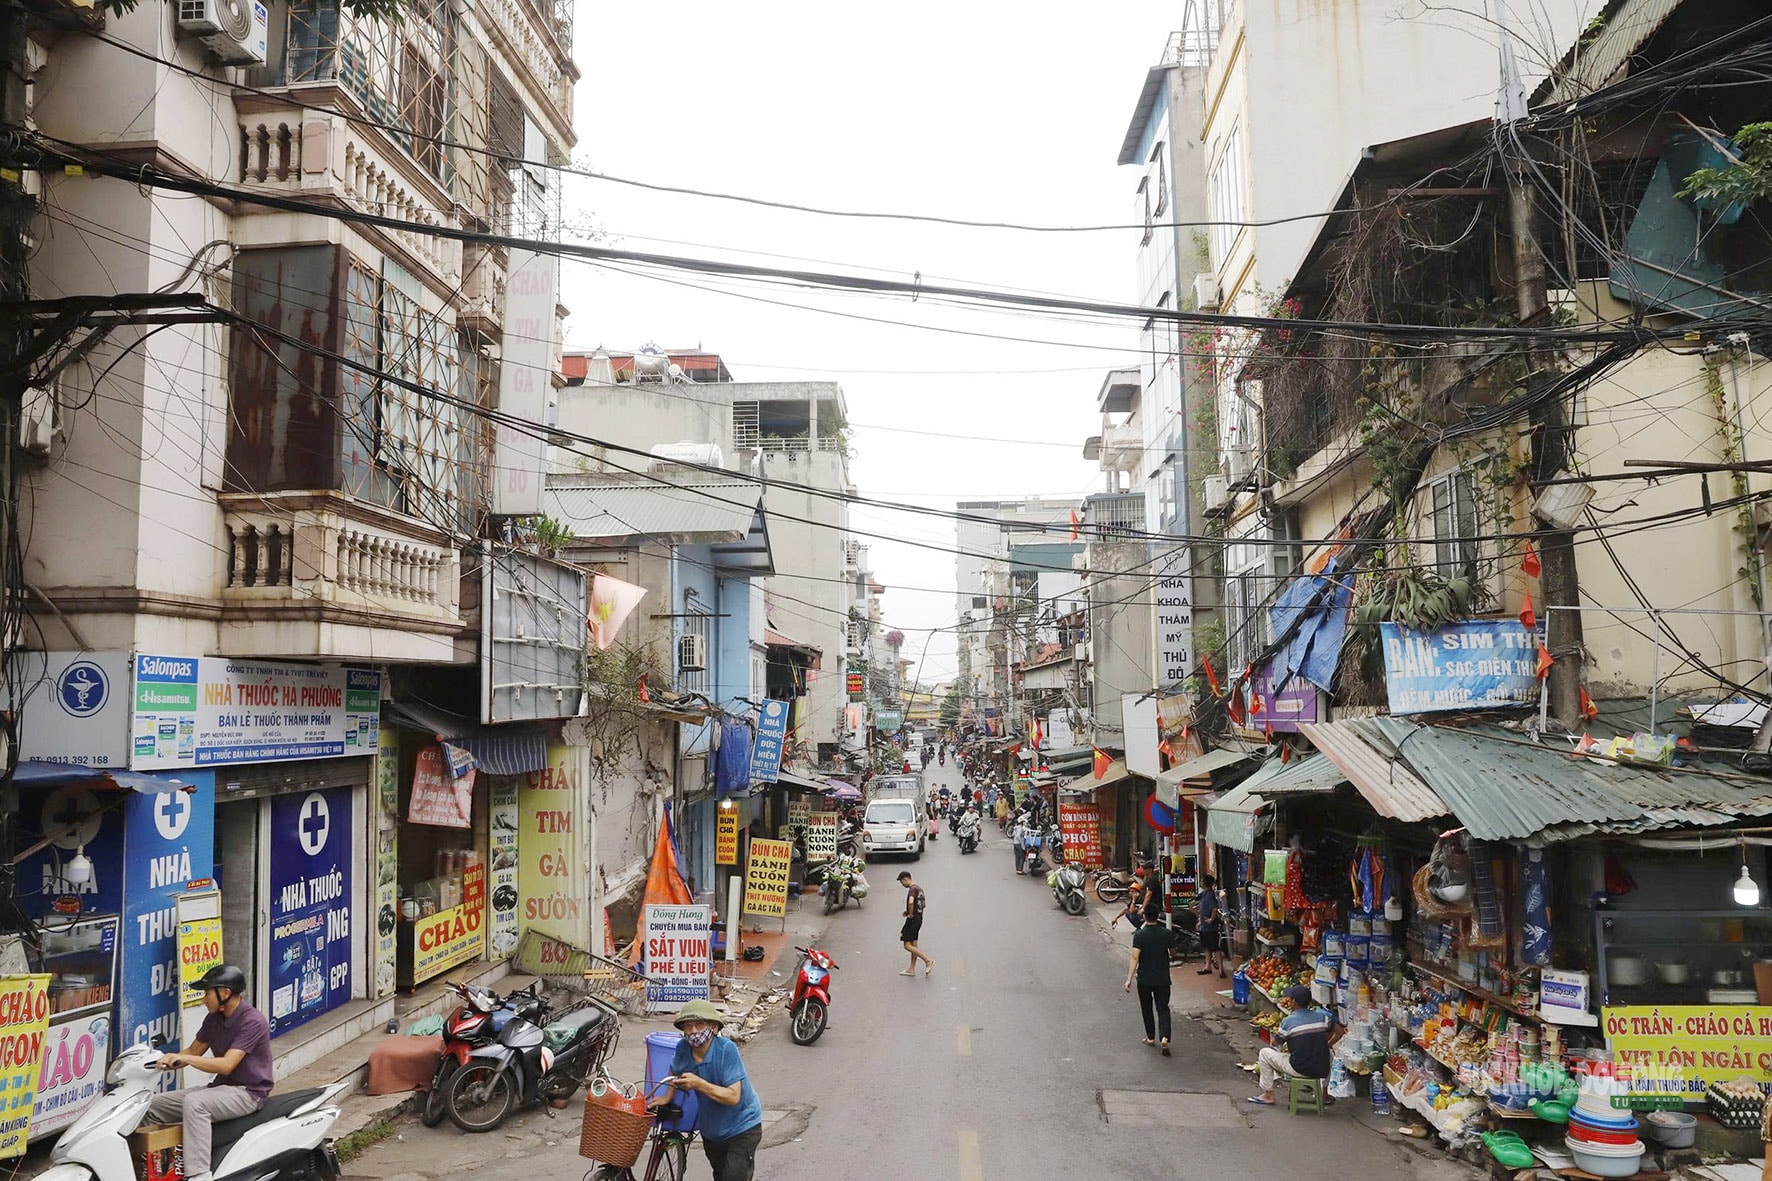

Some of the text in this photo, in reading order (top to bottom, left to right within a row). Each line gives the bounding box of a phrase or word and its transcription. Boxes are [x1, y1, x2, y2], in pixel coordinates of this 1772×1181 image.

[514, 318, 541, 345] TIM
[1160, 579, 1185, 589] NHA
[1157, 597, 1190, 608] KHOA
[1442, 632, 1494, 650] SIM
[141, 656, 192, 680] Salonpas
[205, 677, 342, 708] NHÀ THUỐC HÀ PHƯƠNG
[219, 712, 237, 728] BÁN
[254, 710, 282, 727] THUỐC
[284, 712, 309, 726] THÀNH
[71, 756, 88, 765] 392
[92, 756, 108, 765] 168
[536, 811, 573, 834] TIM
[1062, 829, 1089, 844] PHỞ
[751, 841, 790, 859] BÚN CHẢ
[1063, 846, 1085, 860] CHÁO
[150, 846, 192, 889] NHÀ
[539, 848, 569, 877] GÀ
[751, 858, 788, 871] BÁNH
[749, 870, 786, 882] CUỐN
[282, 863, 342, 913] NHÀ THUỐC
[747, 881, 785, 893] NÓNG
[137, 906, 177, 946] THU
[420, 908, 482, 953] CHÁO
[650, 922, 676, 931] CHUYÊN
[677, 923, 692, 931] MUA
[181, 938, 219, 965] CHÁO
[649, 932, 676, 958] SẮT
[330, 962, 348, 991] GPP
[650, 958, 706, 977] PHẾ LIỆU
[692, 978, 707, 986] INOX
[0, 981, 47, 1028] CHÁO
[1630, 1008, 1674, 1036] TRẦN
[1685, 1011, 1729, 1036] CHÁO
[1732, 1011, 1756, 1036] CÁ
[1701, 1044, 1753, 1070] NGẢI
[1688, 1074, 1707, 1093] BẮC
